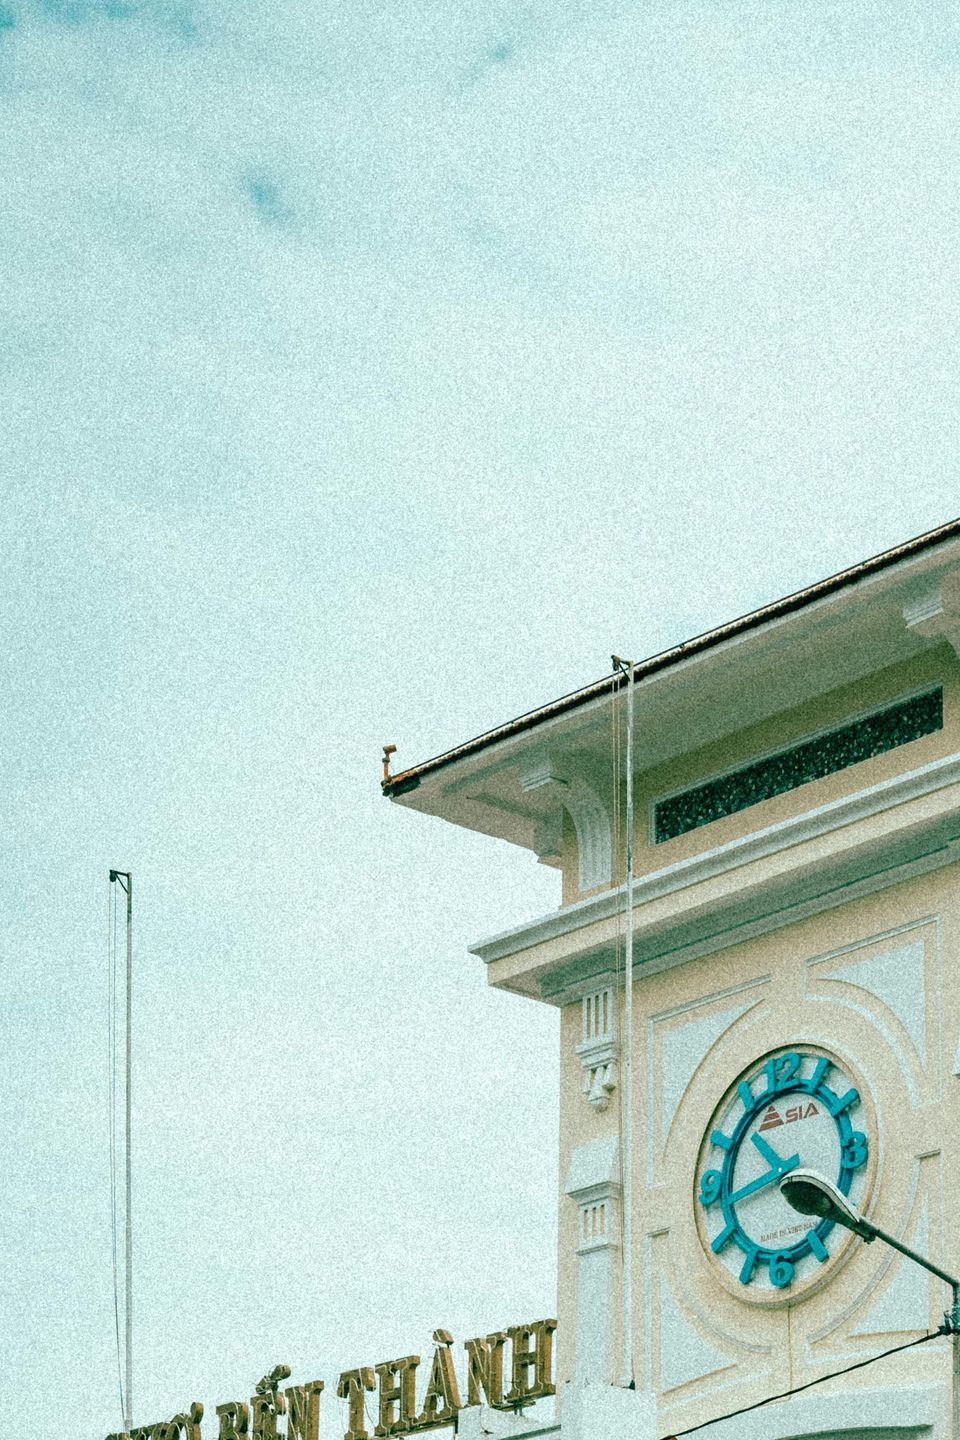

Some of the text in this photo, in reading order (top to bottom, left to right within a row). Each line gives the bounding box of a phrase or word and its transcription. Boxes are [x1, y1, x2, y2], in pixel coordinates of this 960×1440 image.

[763, 1053, 801, 1093] 12
[842, 1132, 868, 1169] 3
[698, 1169, 722, 1206] 9
[769, 1250, 795, 1287] 6
